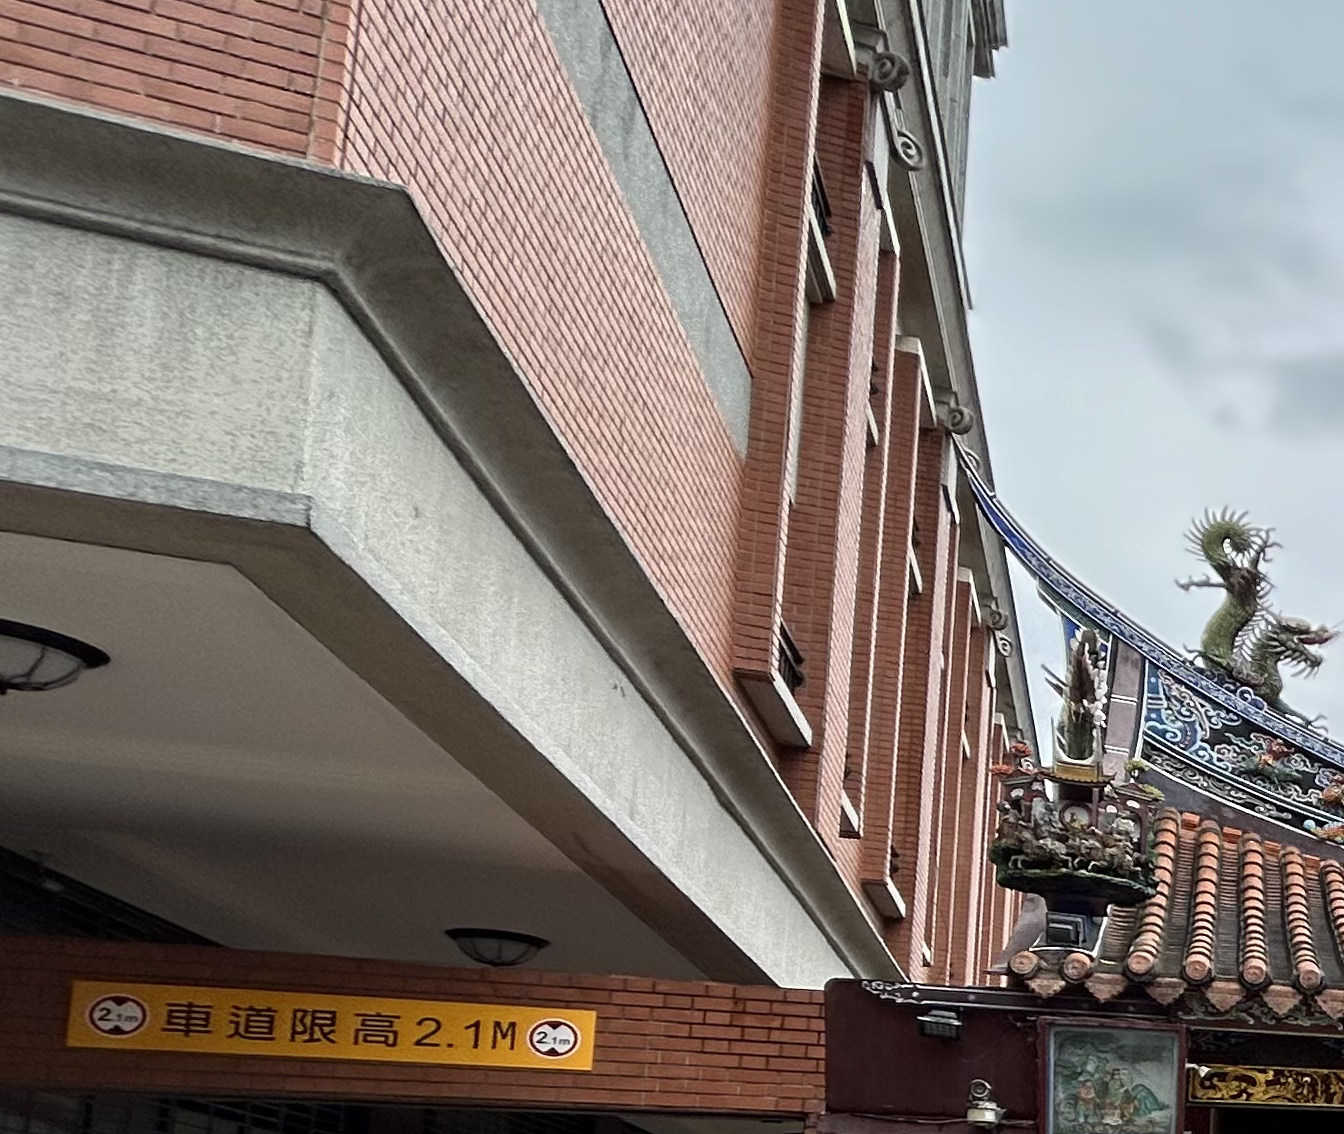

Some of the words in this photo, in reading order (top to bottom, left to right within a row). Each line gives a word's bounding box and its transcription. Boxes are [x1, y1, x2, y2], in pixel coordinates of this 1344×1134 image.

[160, 1002, 517, 1050] 車道限高2.1M
[536, 1031, 570, 1045] 2.1m
